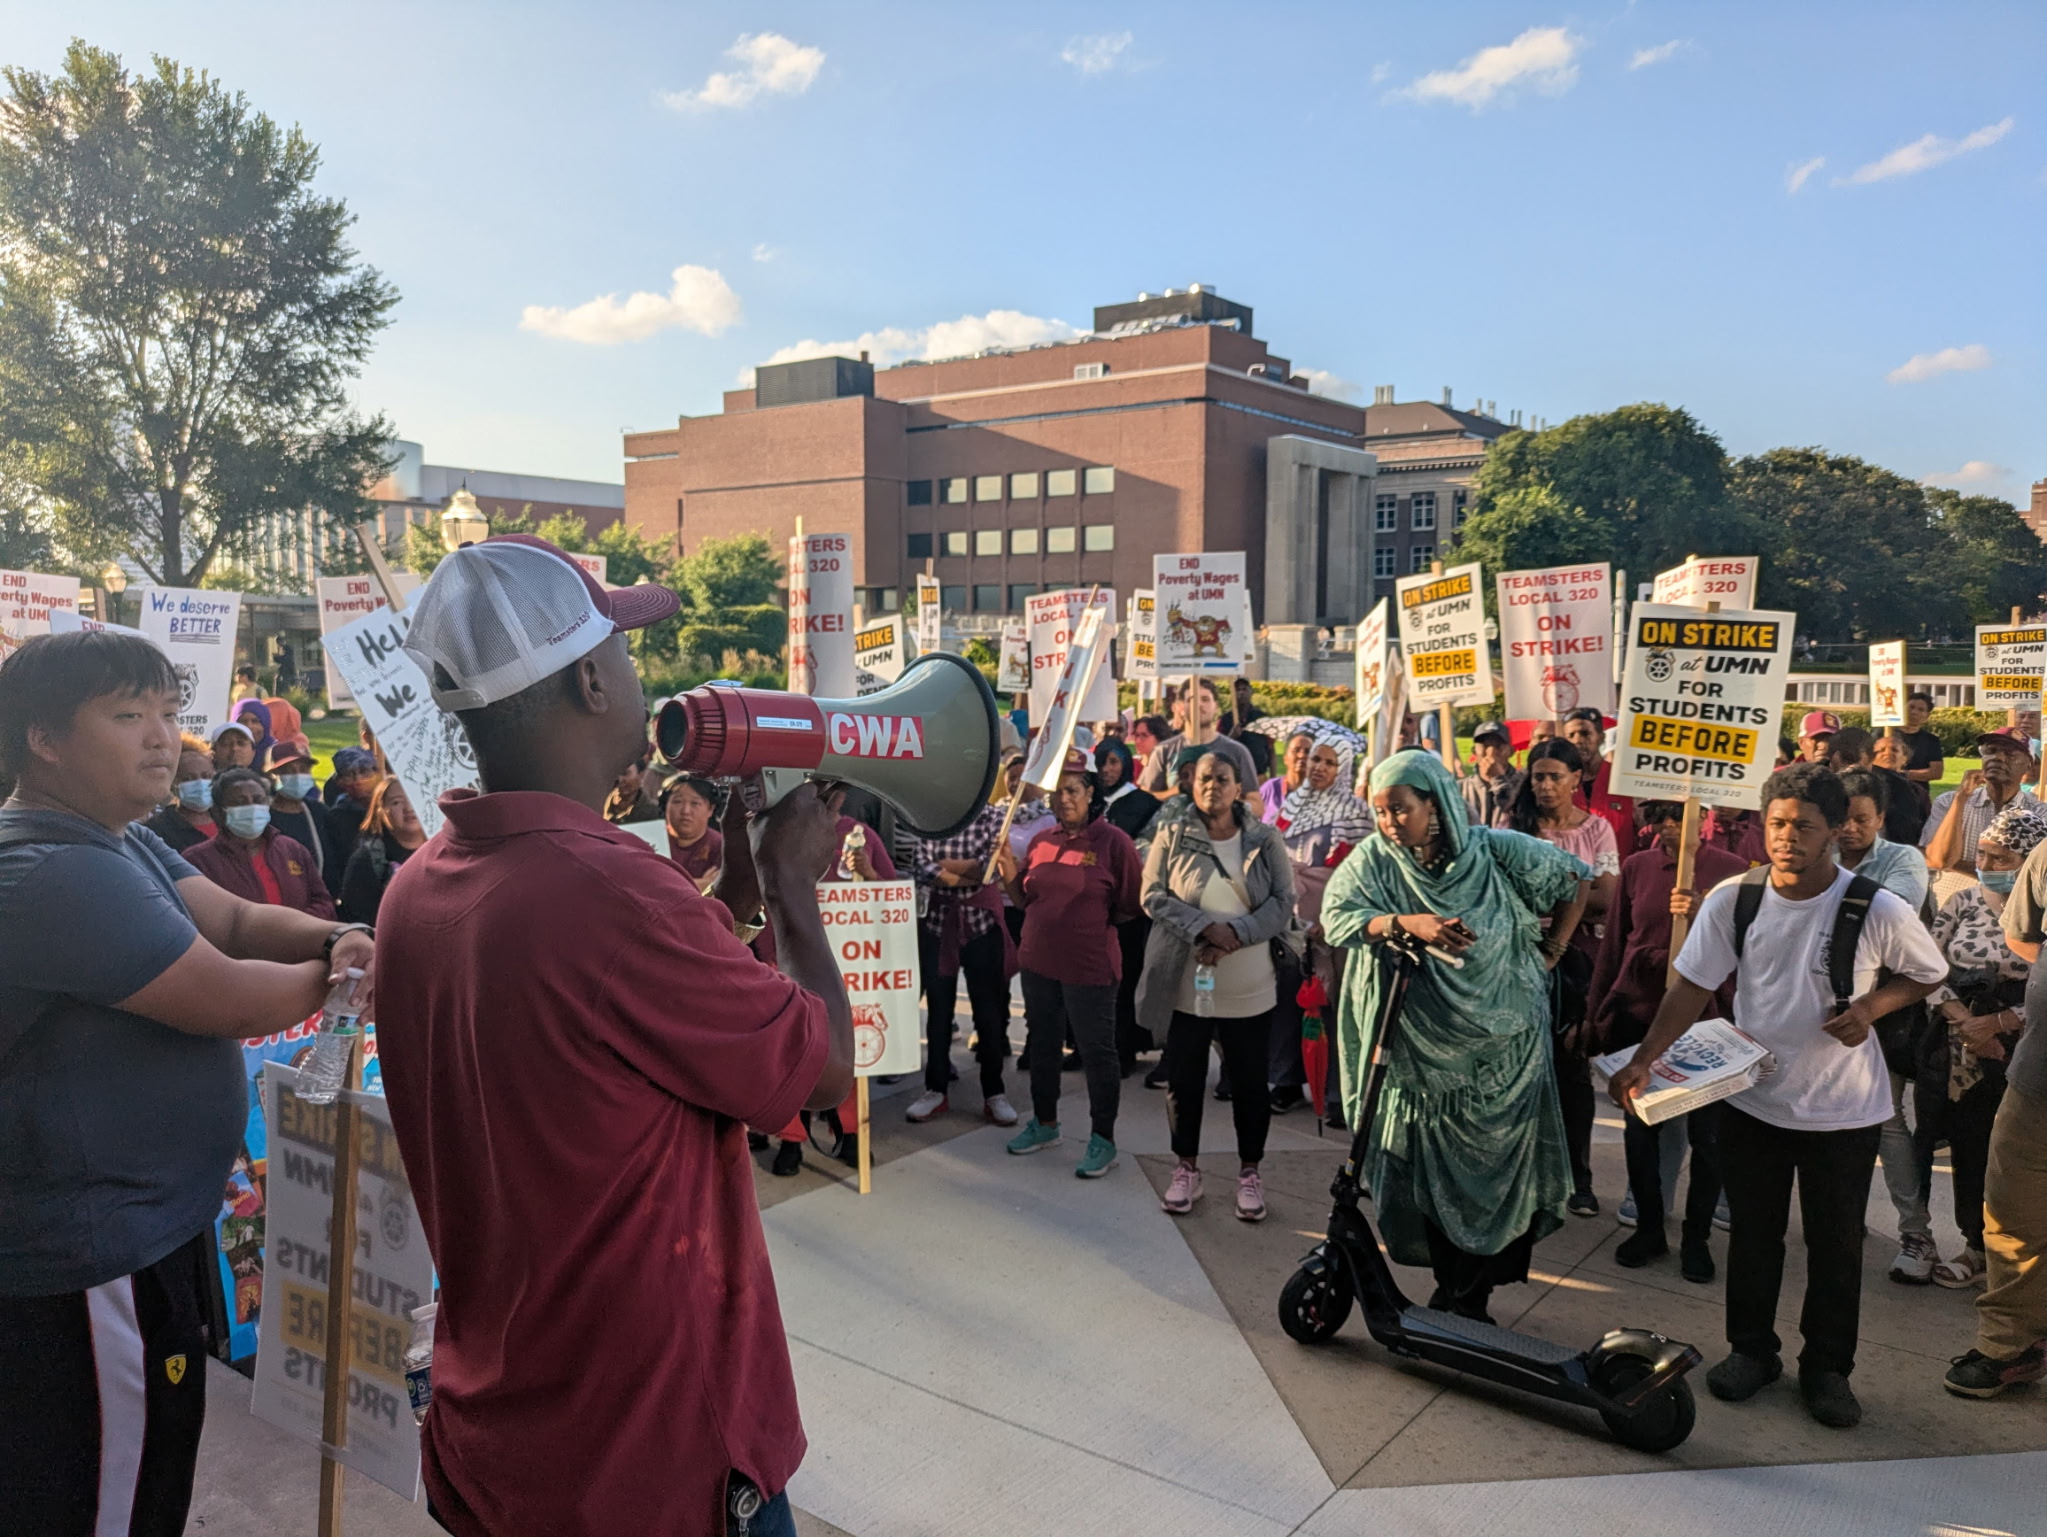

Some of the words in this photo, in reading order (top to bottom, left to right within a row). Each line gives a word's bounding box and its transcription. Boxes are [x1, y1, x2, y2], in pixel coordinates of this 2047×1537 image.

[809, 558, 840, 573] 320
[1179, 558, 1200, 570] END
[3, 574, 27, 588] END
[1158, 573, 1201, 586] Poverty
[1203, 571, 1240, 586] Wages
[1502, 569, 1604, 589] TEAMSTERS
[1704, 581, 1738, 594] 320
[347, 581, 370, 595] END
[790, 587, 811, 607] ON
[1188, 589, 1200, 601] at
[1202, 588, 1225, 601] UMN
[1403, 589, 1421, 607] ON
[1423, 575, 1471, 602] STRIKE
[1509, 592, 1563, 606] LOCAL
[1569, 587, 1598, 601] 320
[0, 591, 28, 606] erty
[31, 591, 73, 608] Wages
[151, 592, 175, 612] We
[180, 595, 231, 615] deserve
[325, 598, 375, 613] Poverty
[1438, 599, 1471, 617] UMN
[12, 607, 26, 619] at
[1033, 607, 1074, 625] LOCAL
[169, 617, 222, 634] BETTER
[790, 614, 844, 635] RIKE!
[1427, 623, 1451, 636] FOR
[1537, 614, 1571, 632] ON
[855, 627, 892, 651] TRIKE
[1406, 633, 1477, 655] STUDENTS
[1642, 622, 1678, 644] ON
[1683, 623, 1774, 648] STRIKE
[1981, 633, 1998, 644] ON
[2000, 629, 2045, 643] STRIKE
[1510, 635, 1604, 657] STRIKE!
[2012, 644, 2044, 654] UMN
[863, 649, 893, 668] UMN
[1416, 653, 1473, 674] BEFORE
[1680, 656, 1704, 671] at
[1704, 656, 1771, 675] UMN
[2001, 657, 2023, 665] FOR
[1979, 666, 2045, 676] STUDENTS
[1418, 674, 1475, 692] PROFITS
[1678, 680, 1723, 698] FOR
[1986, 677, 2039, 689] BEFORE
[375, 684, 417, 718] We
[1985, 691, 2039, 700] PROFITS
[1629, 697, 1768, 725] STUDENTS
[830, 713, 923, 758] CWA
[1640, 720, 1751, 757] BEFORE
[1635, 754, 1746, 780] PROFITS
[1634, 780, 1688, 792] TEAMSTERS
[1690, 786, 1719, 796] LOCAL
[1722, 789, 1742, 798] 320
[816, 886, 912, 904] EAMSTERS
[822, 910, 873, 925] OCAL
[881, 908, 910, 924] 320
[842, 939, 882, 961] ON
[843, 969, 912, 992] RIKE!
